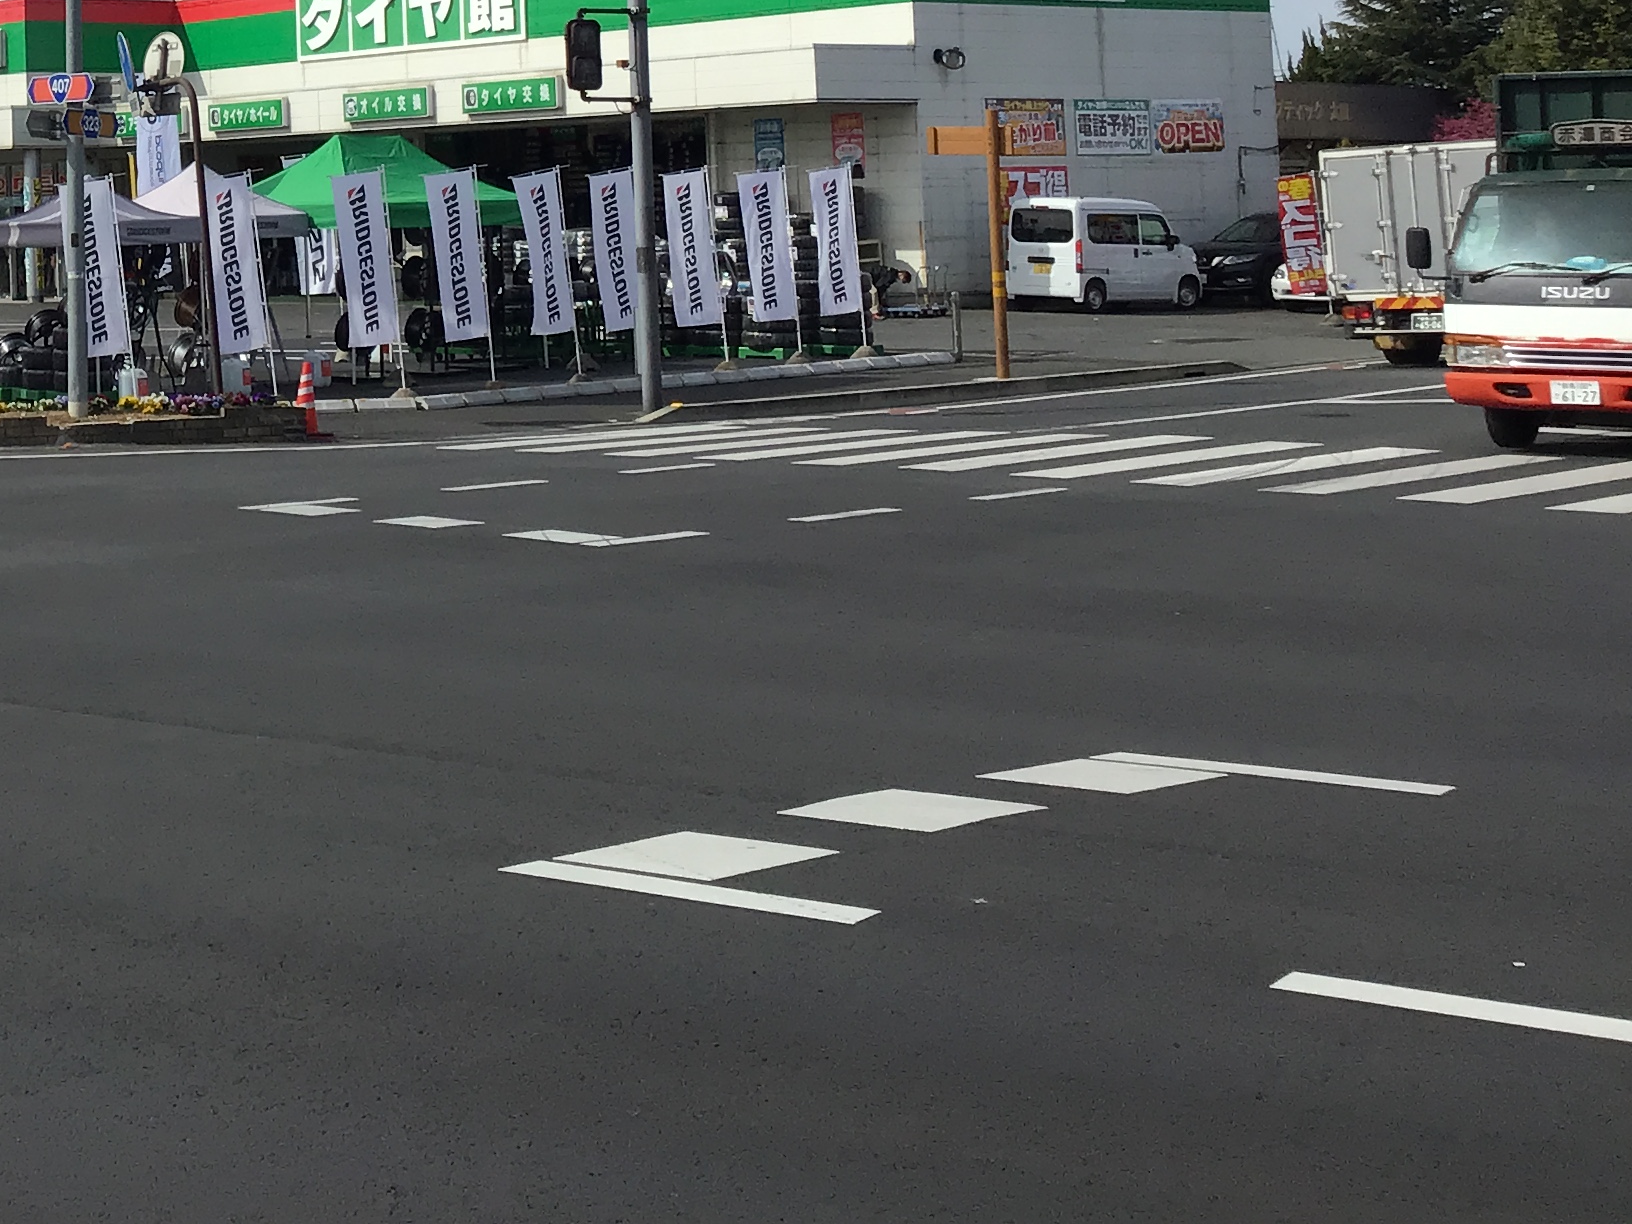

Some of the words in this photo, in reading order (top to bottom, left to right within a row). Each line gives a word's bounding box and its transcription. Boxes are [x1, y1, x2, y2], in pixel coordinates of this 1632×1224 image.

[52, 78, 70, 94] 407
[480, 84, 551, 105] タイヤ交換
[222, 106, 278, 125] タイヤ/ホイール
[360, 96, 423, 116] オイル交換
[83, 115, 100, 131] 323
[1077, 113, 1136, 137] 電話予約
[1159, 121, 1219, 146] OPEN
[1540, 286, 1611, 299] ISUZU
[1561, 390, 1598, 403] 61-27
